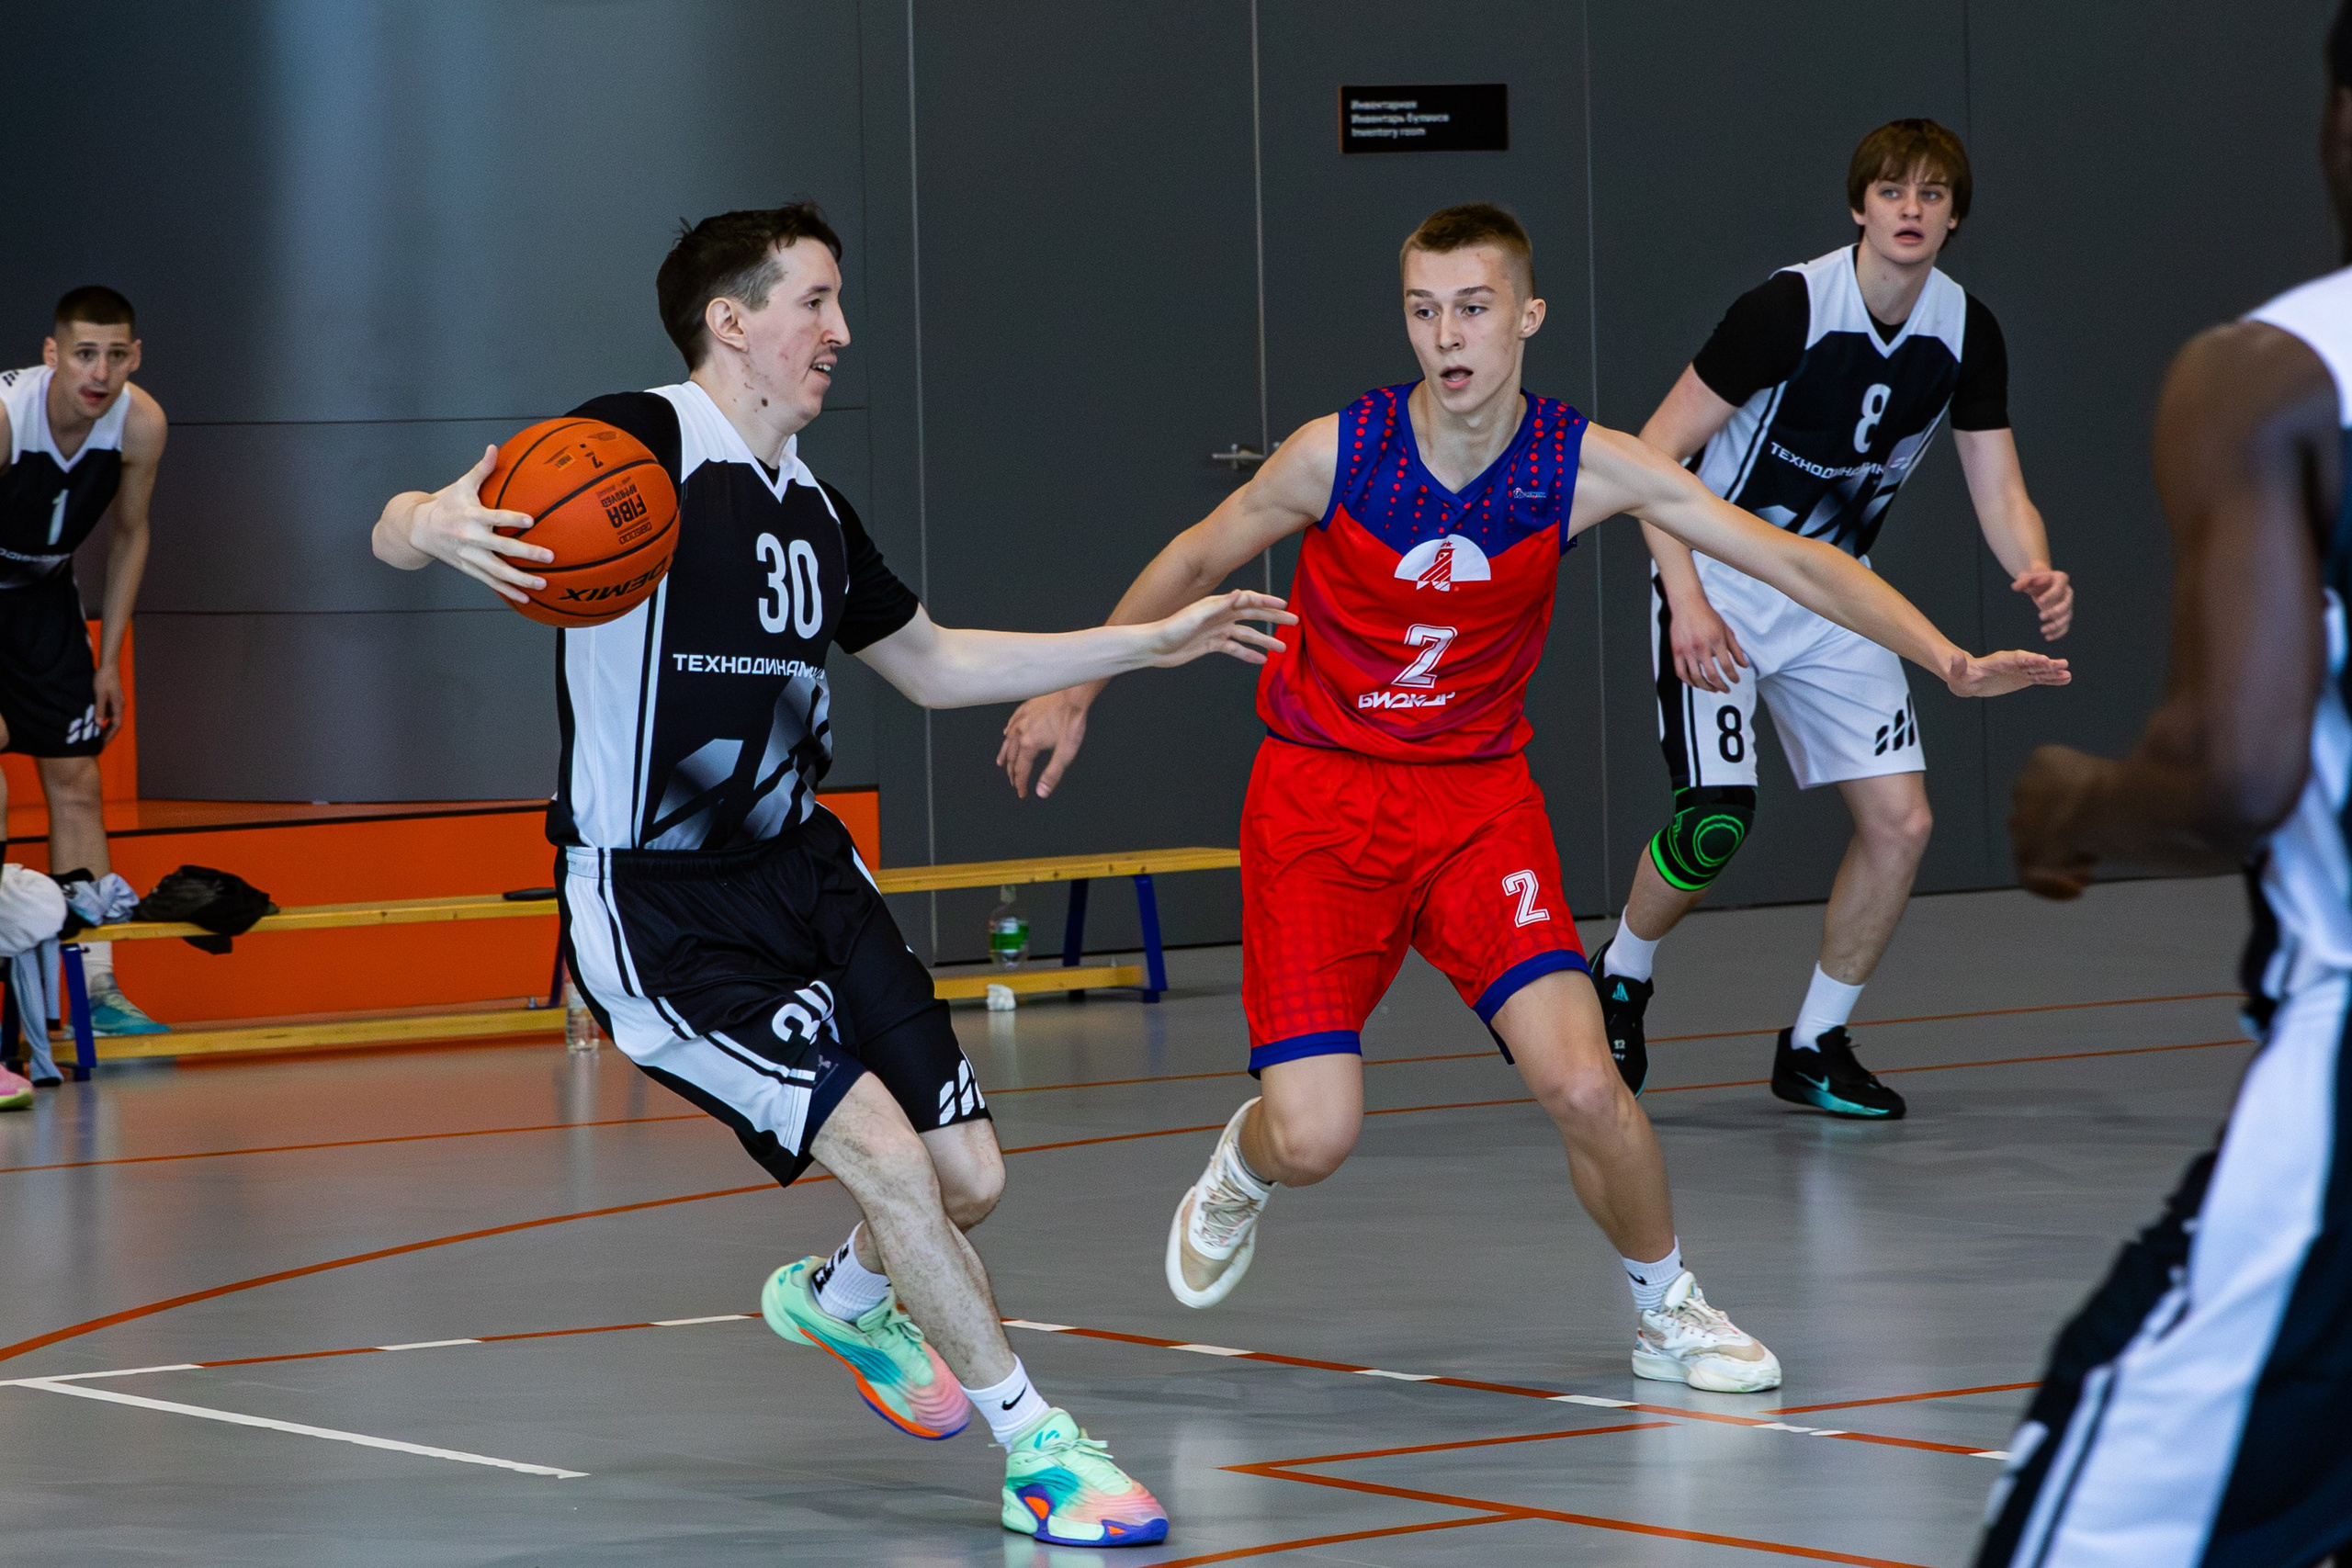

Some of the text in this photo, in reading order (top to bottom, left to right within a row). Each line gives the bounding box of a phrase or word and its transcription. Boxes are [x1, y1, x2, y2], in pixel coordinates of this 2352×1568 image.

[1854, 383, 1892, 454] 8
[48, 489, 69, 546] 1
[606, 493, 648, 529] FIBA
[558, 556, 669, 602] DEMIX
[756, 532, 823, 639] 30
[1391, 624, 1458, 689] 2
[1716, 705, 1745, 763] 8
[1502, 869, 1550, 928] 2
